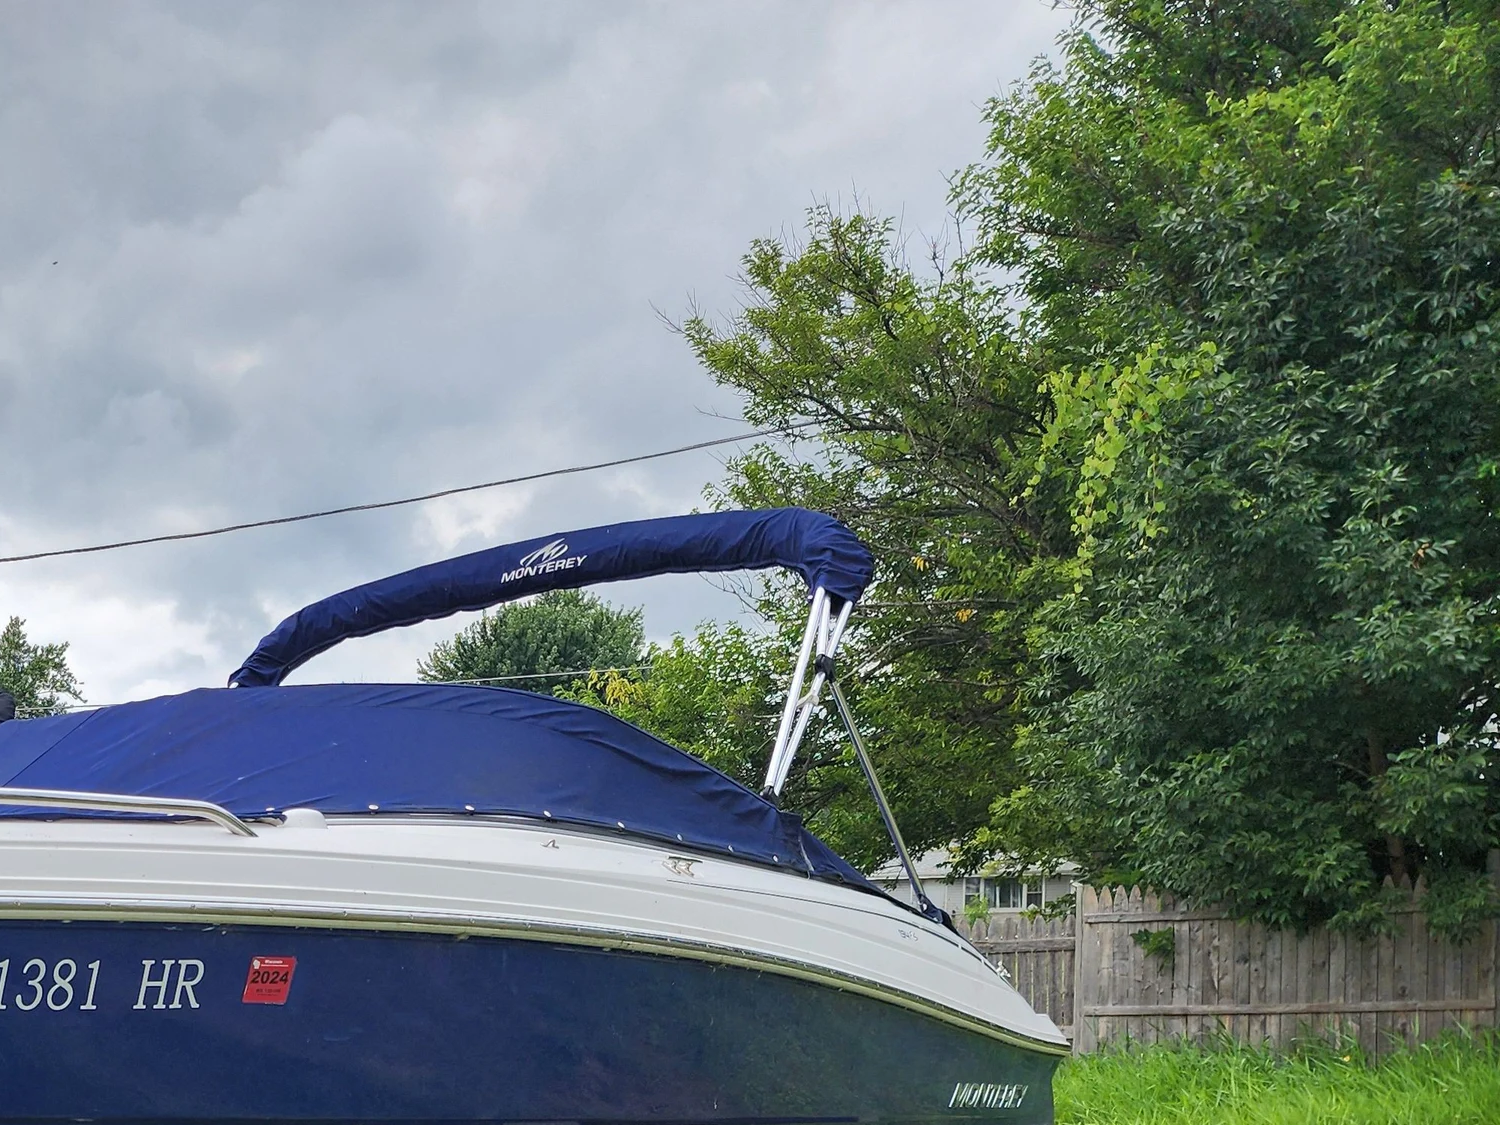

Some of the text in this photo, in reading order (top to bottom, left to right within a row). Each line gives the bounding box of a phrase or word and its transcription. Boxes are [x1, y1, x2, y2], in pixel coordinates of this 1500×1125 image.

[500, 555, 588, 583] MONTEREY
[132, 959, 205, 1010] HR
[250, 970, 290, 985] 2024
[948, 1082, 1029, 1108] MONTEREY
